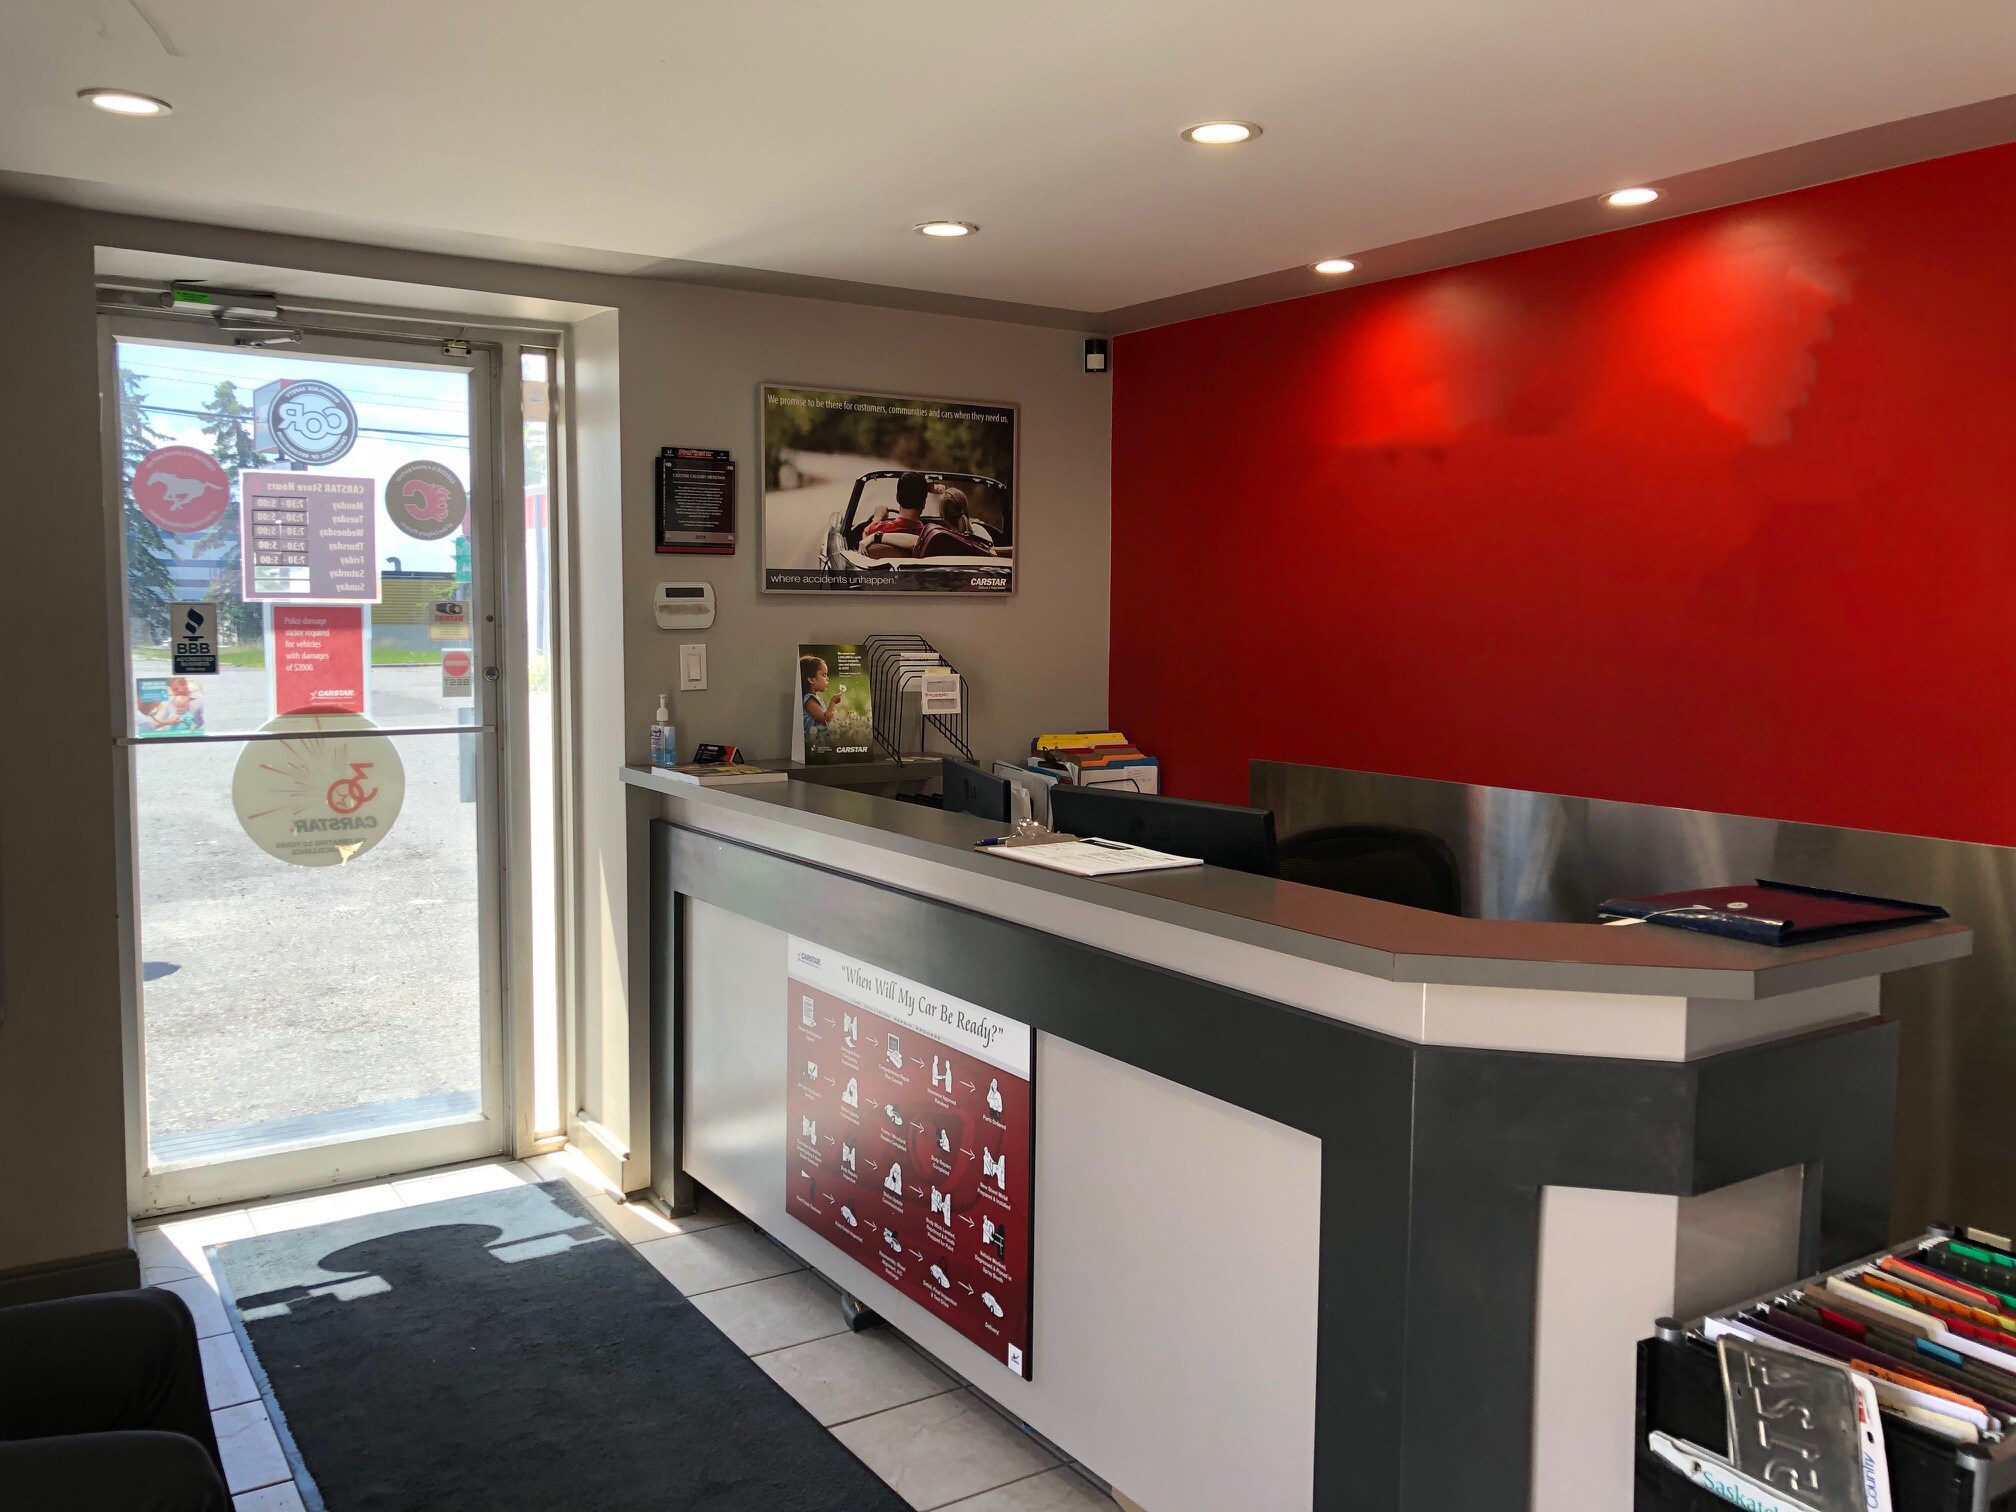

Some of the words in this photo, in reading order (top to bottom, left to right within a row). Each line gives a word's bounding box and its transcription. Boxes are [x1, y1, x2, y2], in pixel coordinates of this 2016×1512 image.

[767, 394, 779, 404] We
[780, 396, 807, 407] promise
[807, 399, 814, 407] to
[816, 399, 824, 408] be
[825, 400, 842, 410] there
[843, 401, 852, 410] for
[854, 403, 888, 414] customers,
[888, 405, 927, 417] communities
[928, 409, 940, 418] and
[941, 411, 955, 419] cars
[955, 410, 971, 420] when
[971, 412, 984, 423] they
[985, 413, 1000, 422] need
[770, 574, 801, 583] where
[802, 575, 848, 584] accidents
[970, 578, 1006, 586] CARSTAR
[302, 617, 327, 626] damage
[305, 629, 330, 638] required
[177, 643, 210, 654] BBB
[296, 640, 322, 648] vehicles
[285, 652, 300, 660] with
[301, 652, 330, 662] damages
[317, 689, 354, 697] CARSTAR
[875, 977, 897, 1000] Will
[898, 987, 915, 1016] My
[918, 996, 937, 1017] Car
[940, 1004, 953, 1024] Be
[1703, 1471, 1779, 1512] Saskat
